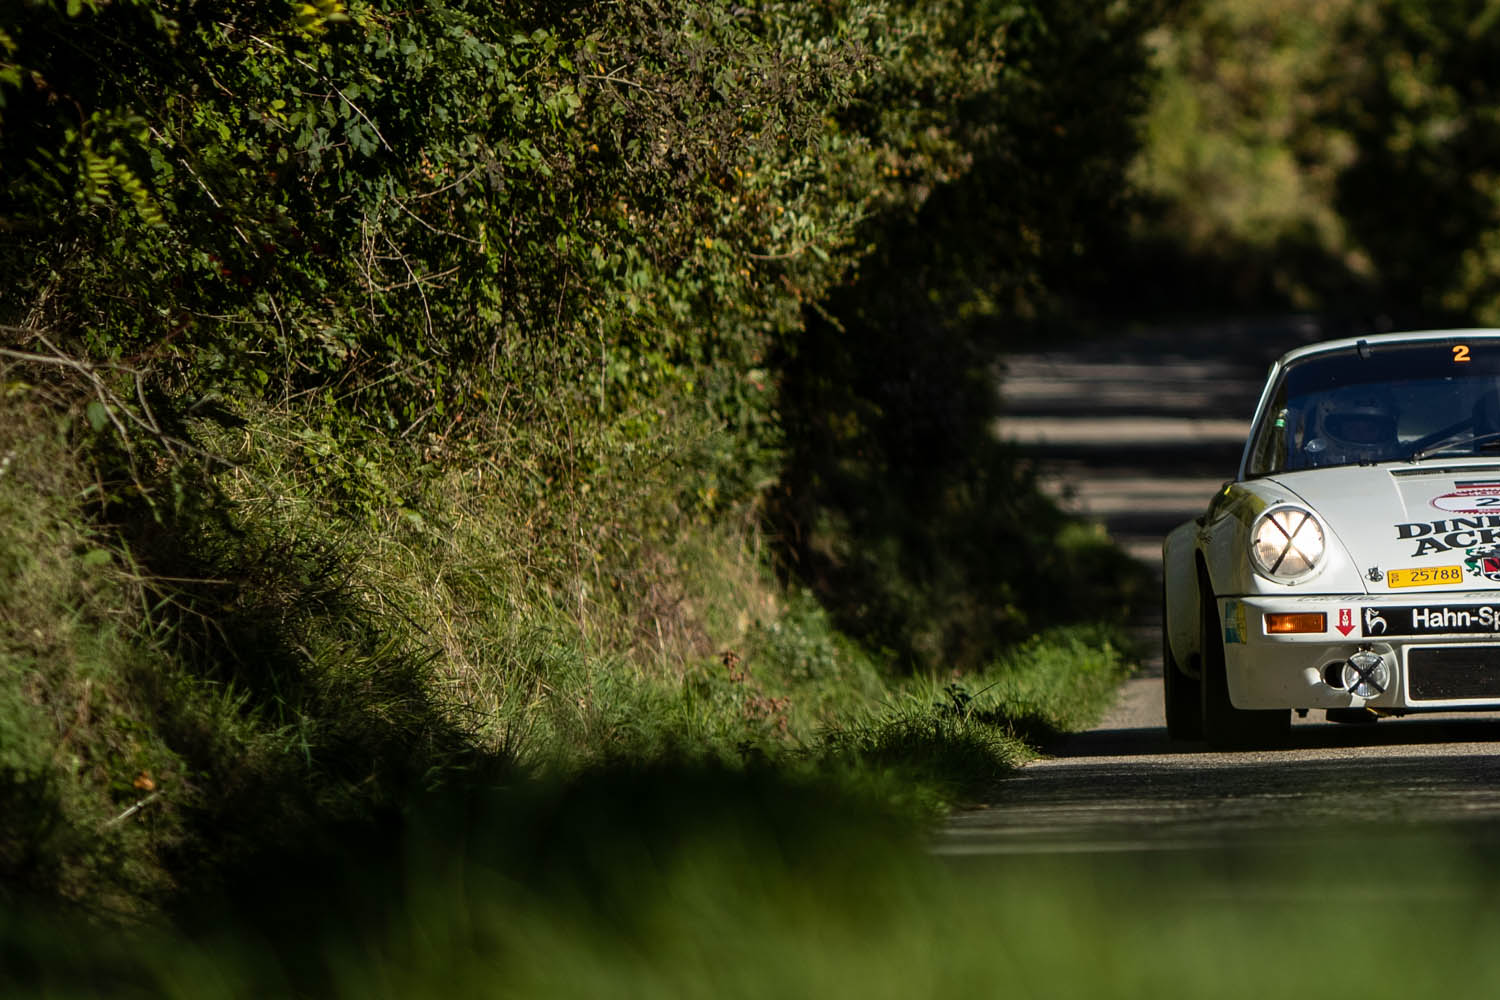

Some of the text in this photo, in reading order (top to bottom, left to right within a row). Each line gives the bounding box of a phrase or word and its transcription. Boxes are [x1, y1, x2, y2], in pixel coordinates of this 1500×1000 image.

[1451, 344, 1471, 363] 2
[1410, 568, 1460, 582] 25788
[1342, 609, 1350, 627] TOW
